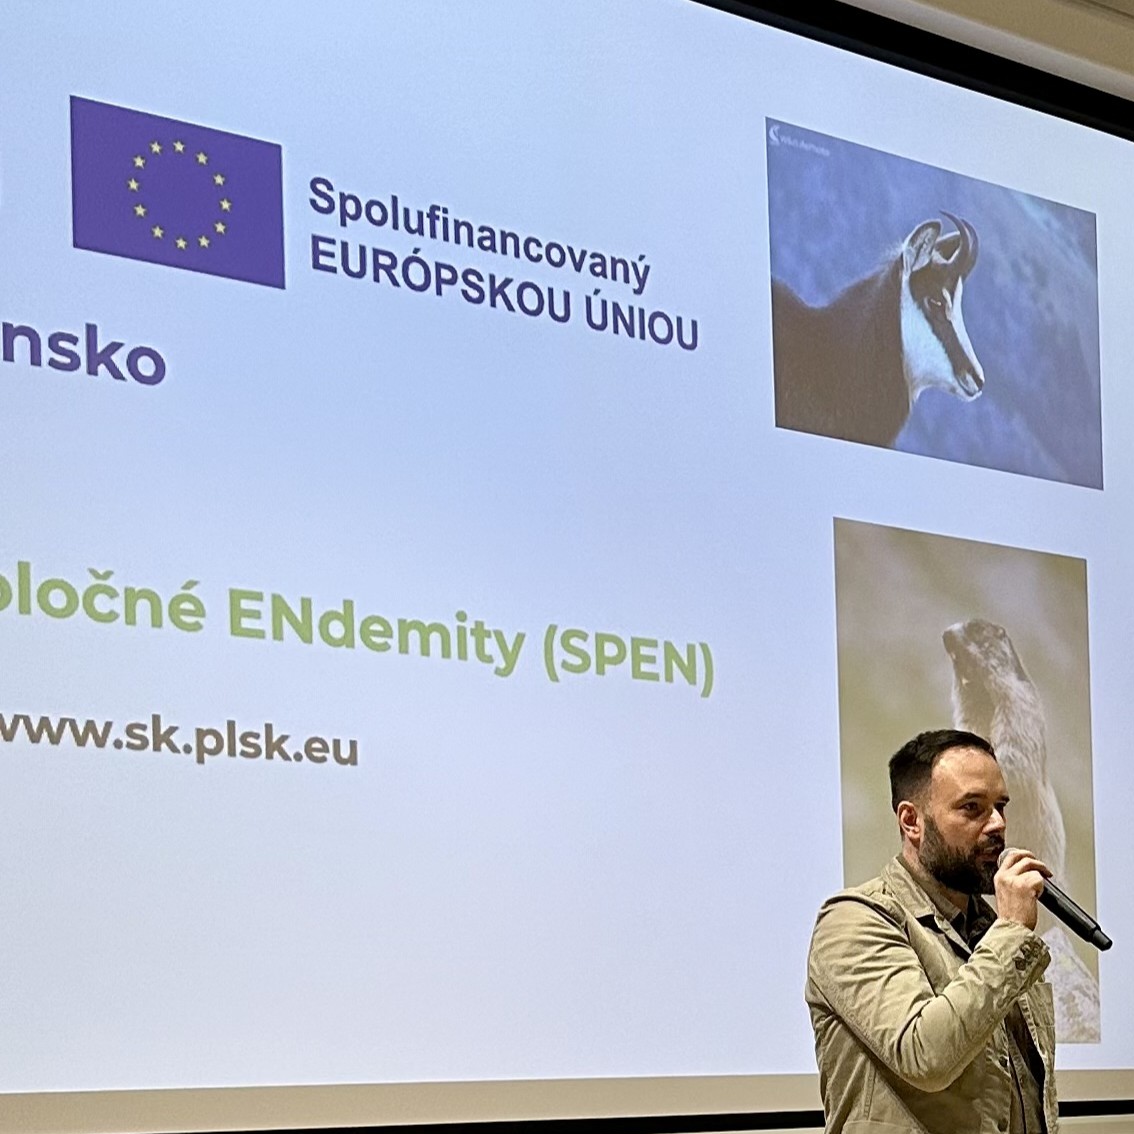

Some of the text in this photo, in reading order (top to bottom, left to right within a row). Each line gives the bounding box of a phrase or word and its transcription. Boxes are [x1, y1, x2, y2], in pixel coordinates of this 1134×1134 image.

[309, 176, 651, 295] Spolufinancovaný
[311, 233, 699, 351] EURÓPSKOU ÚNIOU
[0, 560, 714, 698] ločné ENdemity (SPEN)
